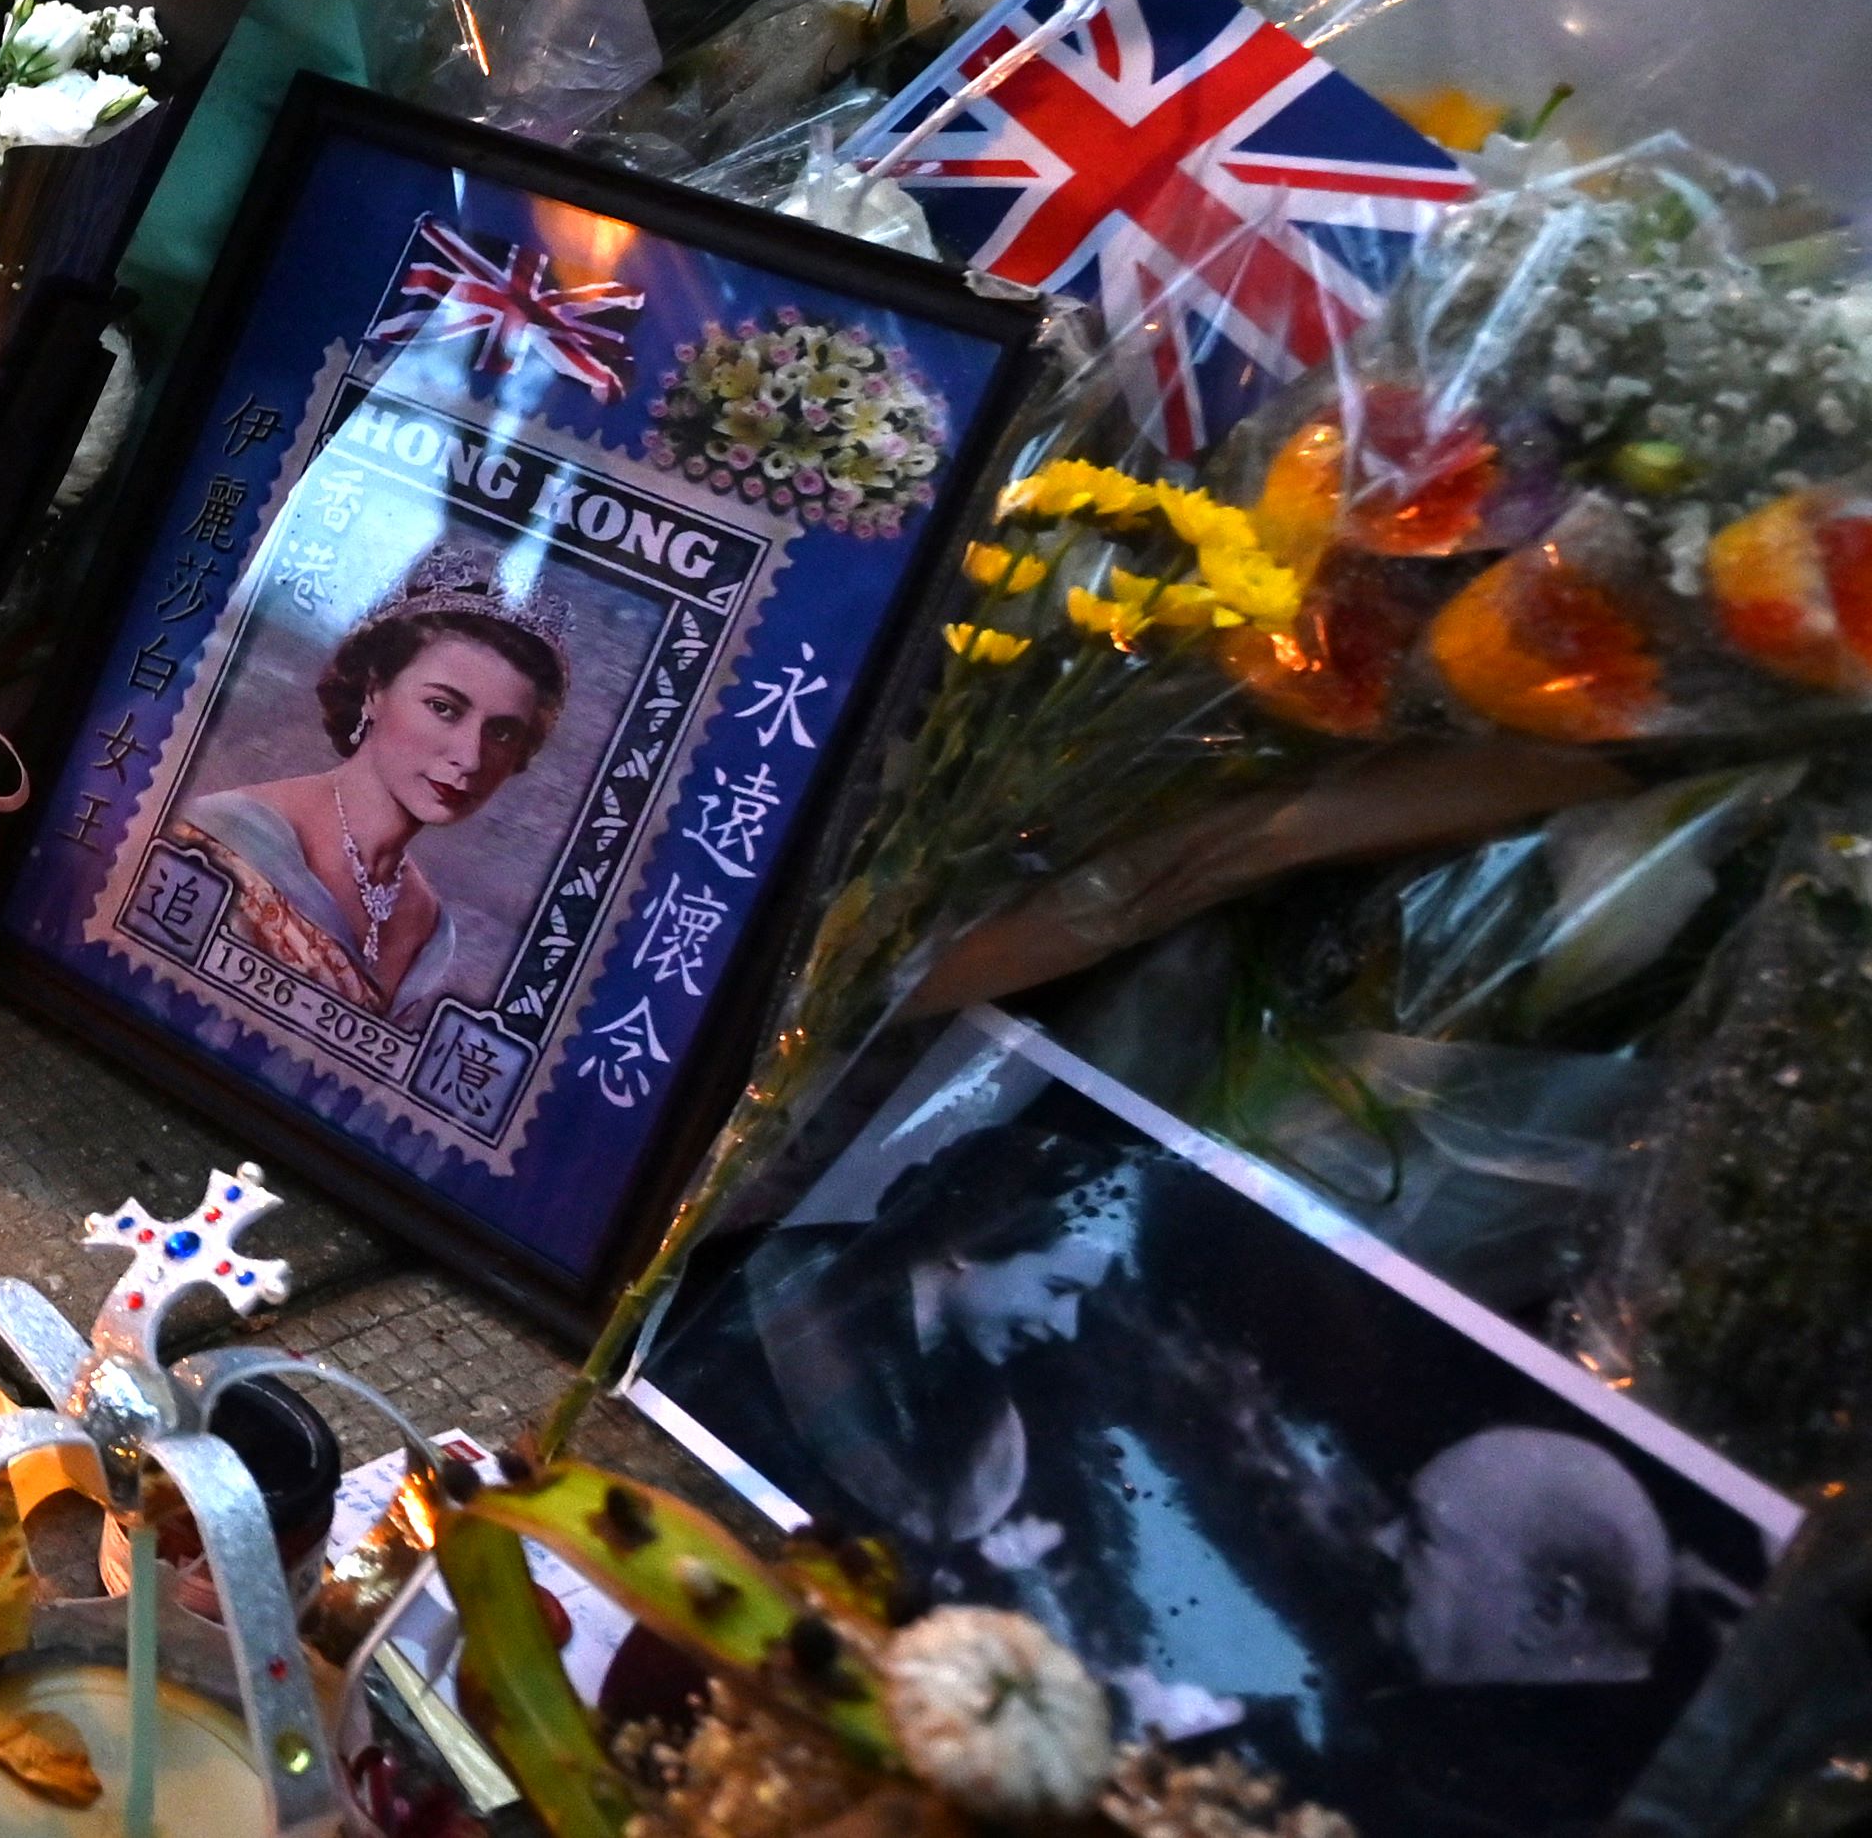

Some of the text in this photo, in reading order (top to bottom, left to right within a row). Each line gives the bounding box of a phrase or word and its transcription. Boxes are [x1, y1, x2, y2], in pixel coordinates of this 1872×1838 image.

[275, 468, 365, 612] 香港
[346, 402, 719, 580] HONG KONG
[57, 392, 286, 853] 伊麗莎白女王
[135, 868, 193, 946] 追
[577, 641, 828, 1108] 永遠懷念
[216, 945, 403, 1070] 1926-2022
[429, 1024, 504, 1116] 憶
